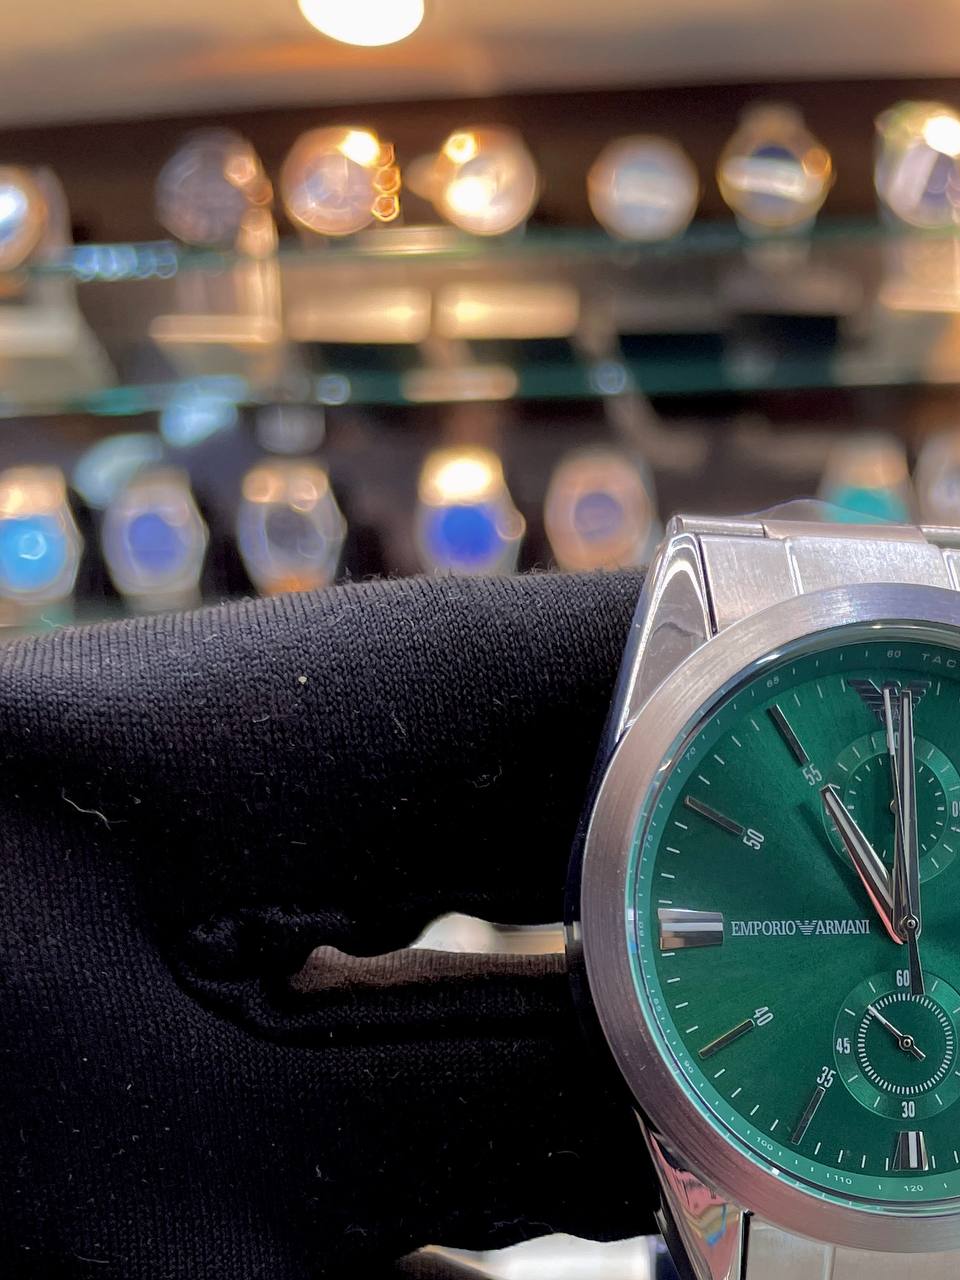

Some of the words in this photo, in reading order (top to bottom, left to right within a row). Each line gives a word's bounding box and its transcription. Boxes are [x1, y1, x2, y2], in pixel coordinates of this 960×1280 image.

[802, 763, 823, 786] 55
[743, 828, 765, 850] 50
[731, 920, 796, 936] EMPORIO
[815, 919, 871, 935] ARMANI
[896, 969, 910, 987] 60
[753, 1006, 774, 1027] 40
[836, 1037, 851, 1054] 45
[816, 1066, 837, 1088] 35
[901, 1101, 916, 1118] 30
[756, 1136, 774, 1151] 100
[834, 1174, 852, 1185] 110
[904, 1184, 924, 1192] 120
